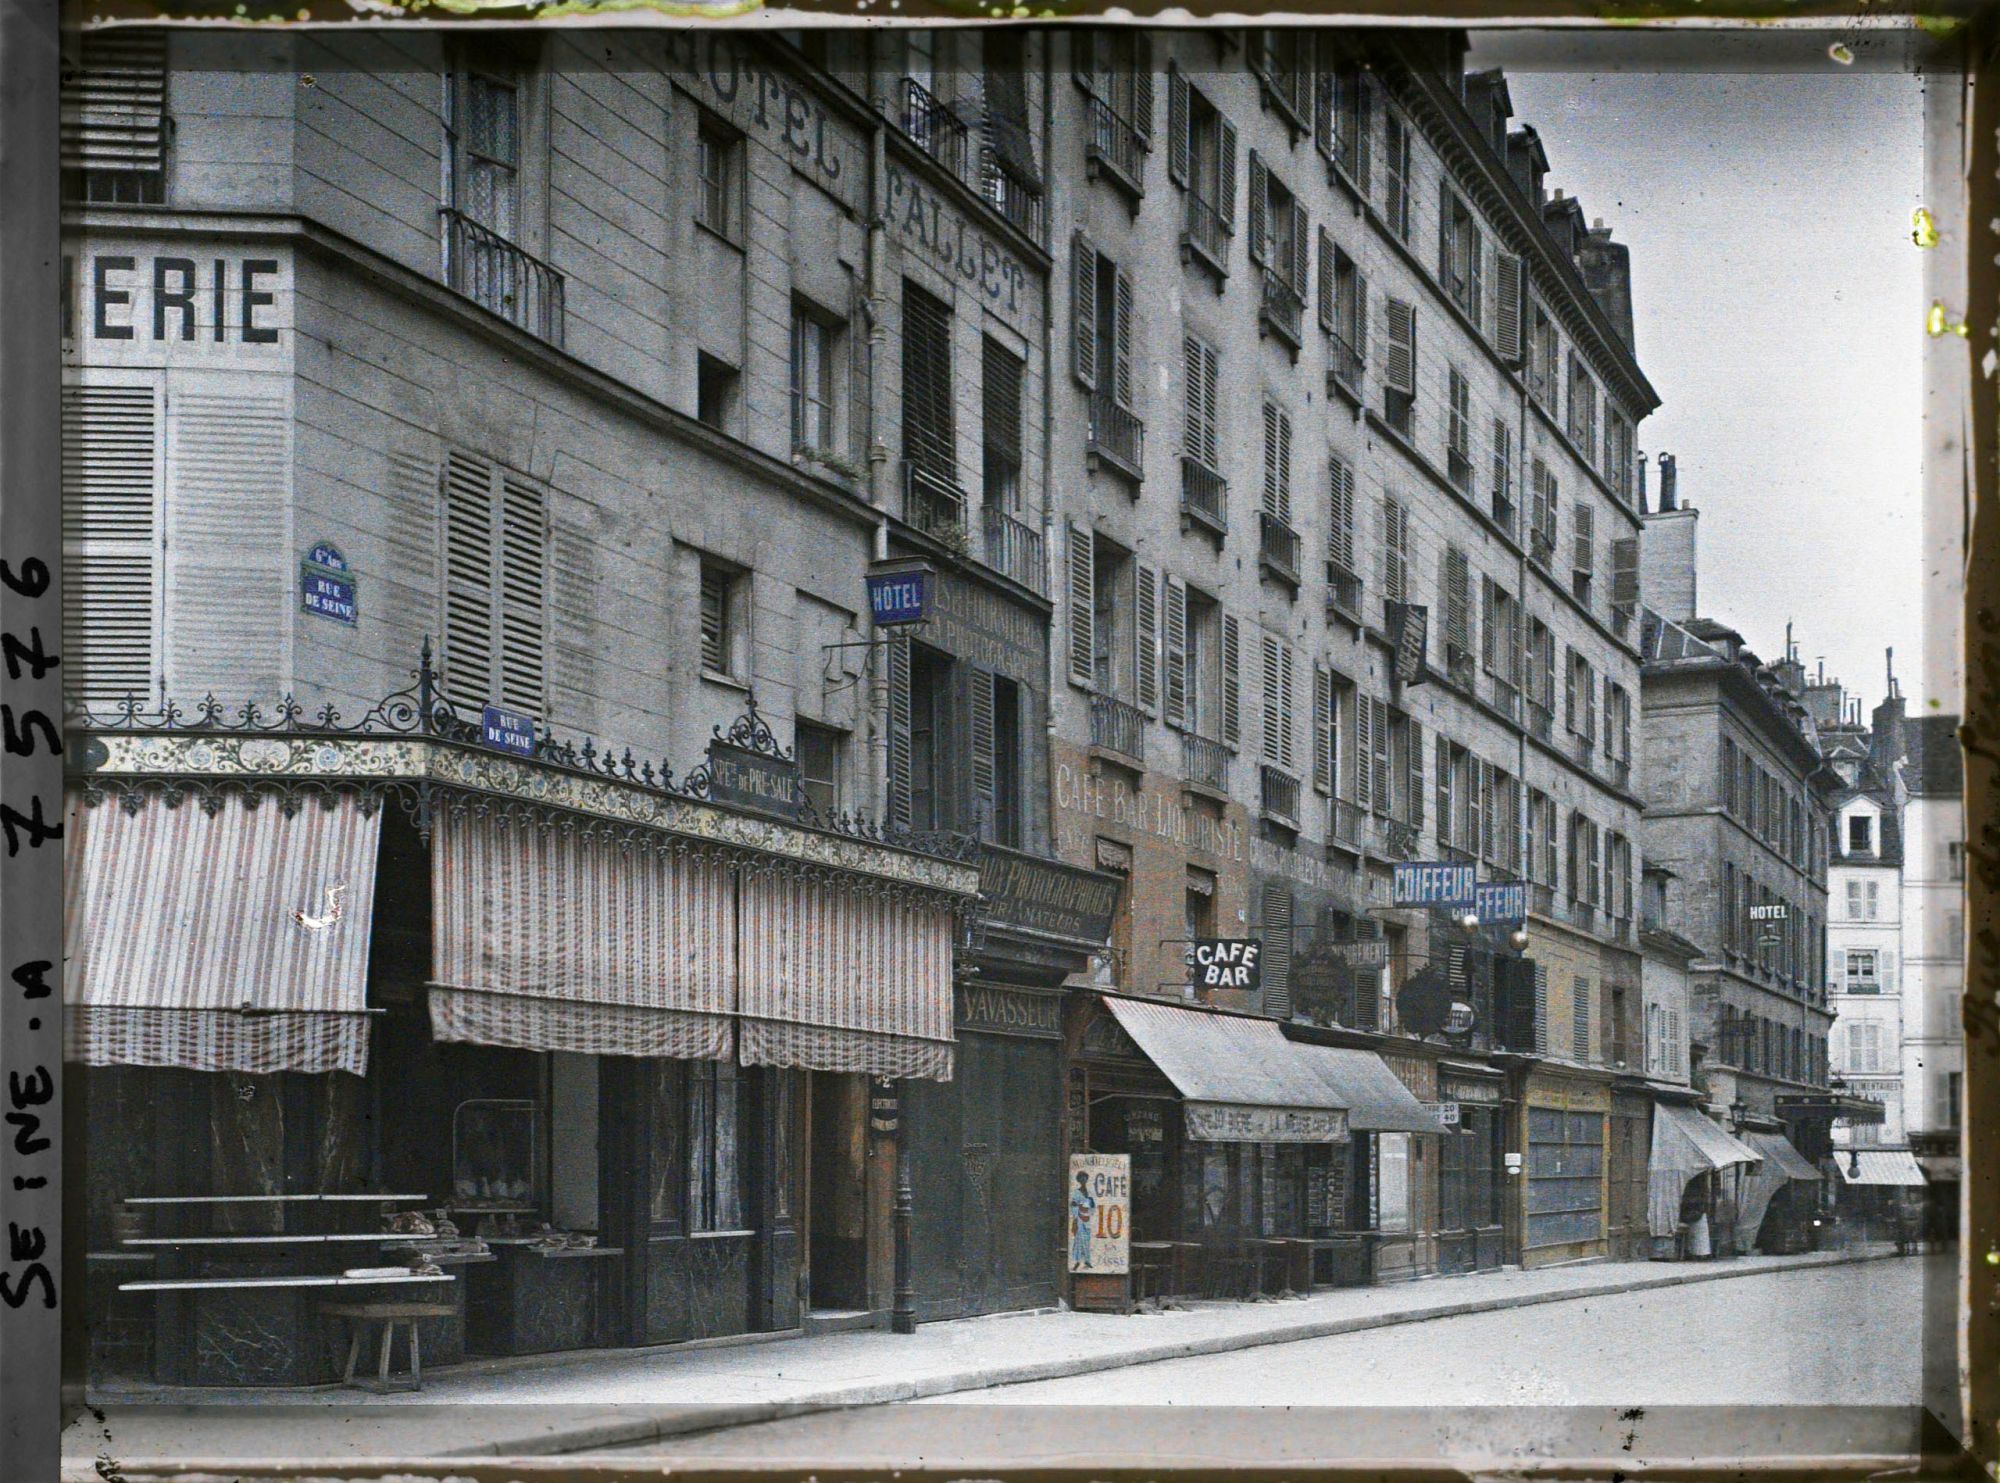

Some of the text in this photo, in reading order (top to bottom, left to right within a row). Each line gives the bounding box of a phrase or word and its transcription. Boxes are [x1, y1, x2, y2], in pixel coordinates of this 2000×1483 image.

[318, 580, 340, 597] RUE
[873, 582, 920, 612] HÔTEL
[305, 592, 353, 617] DE SEINE
[500, 714, 519, 731] RUE
[488, 727, 531, 749] DE SEINE
[1114, 779, 1150, 831] BAR
[1156, 793, 1242, 862] LIQUORISTE
[1395, 867, 1474, 902] COIFFEUR
[1750, 905, 1787, 919] HOTEL
[1197, 942, 1259, 967] CAFÉ
[1204, 964, 1250, 986] BAR
